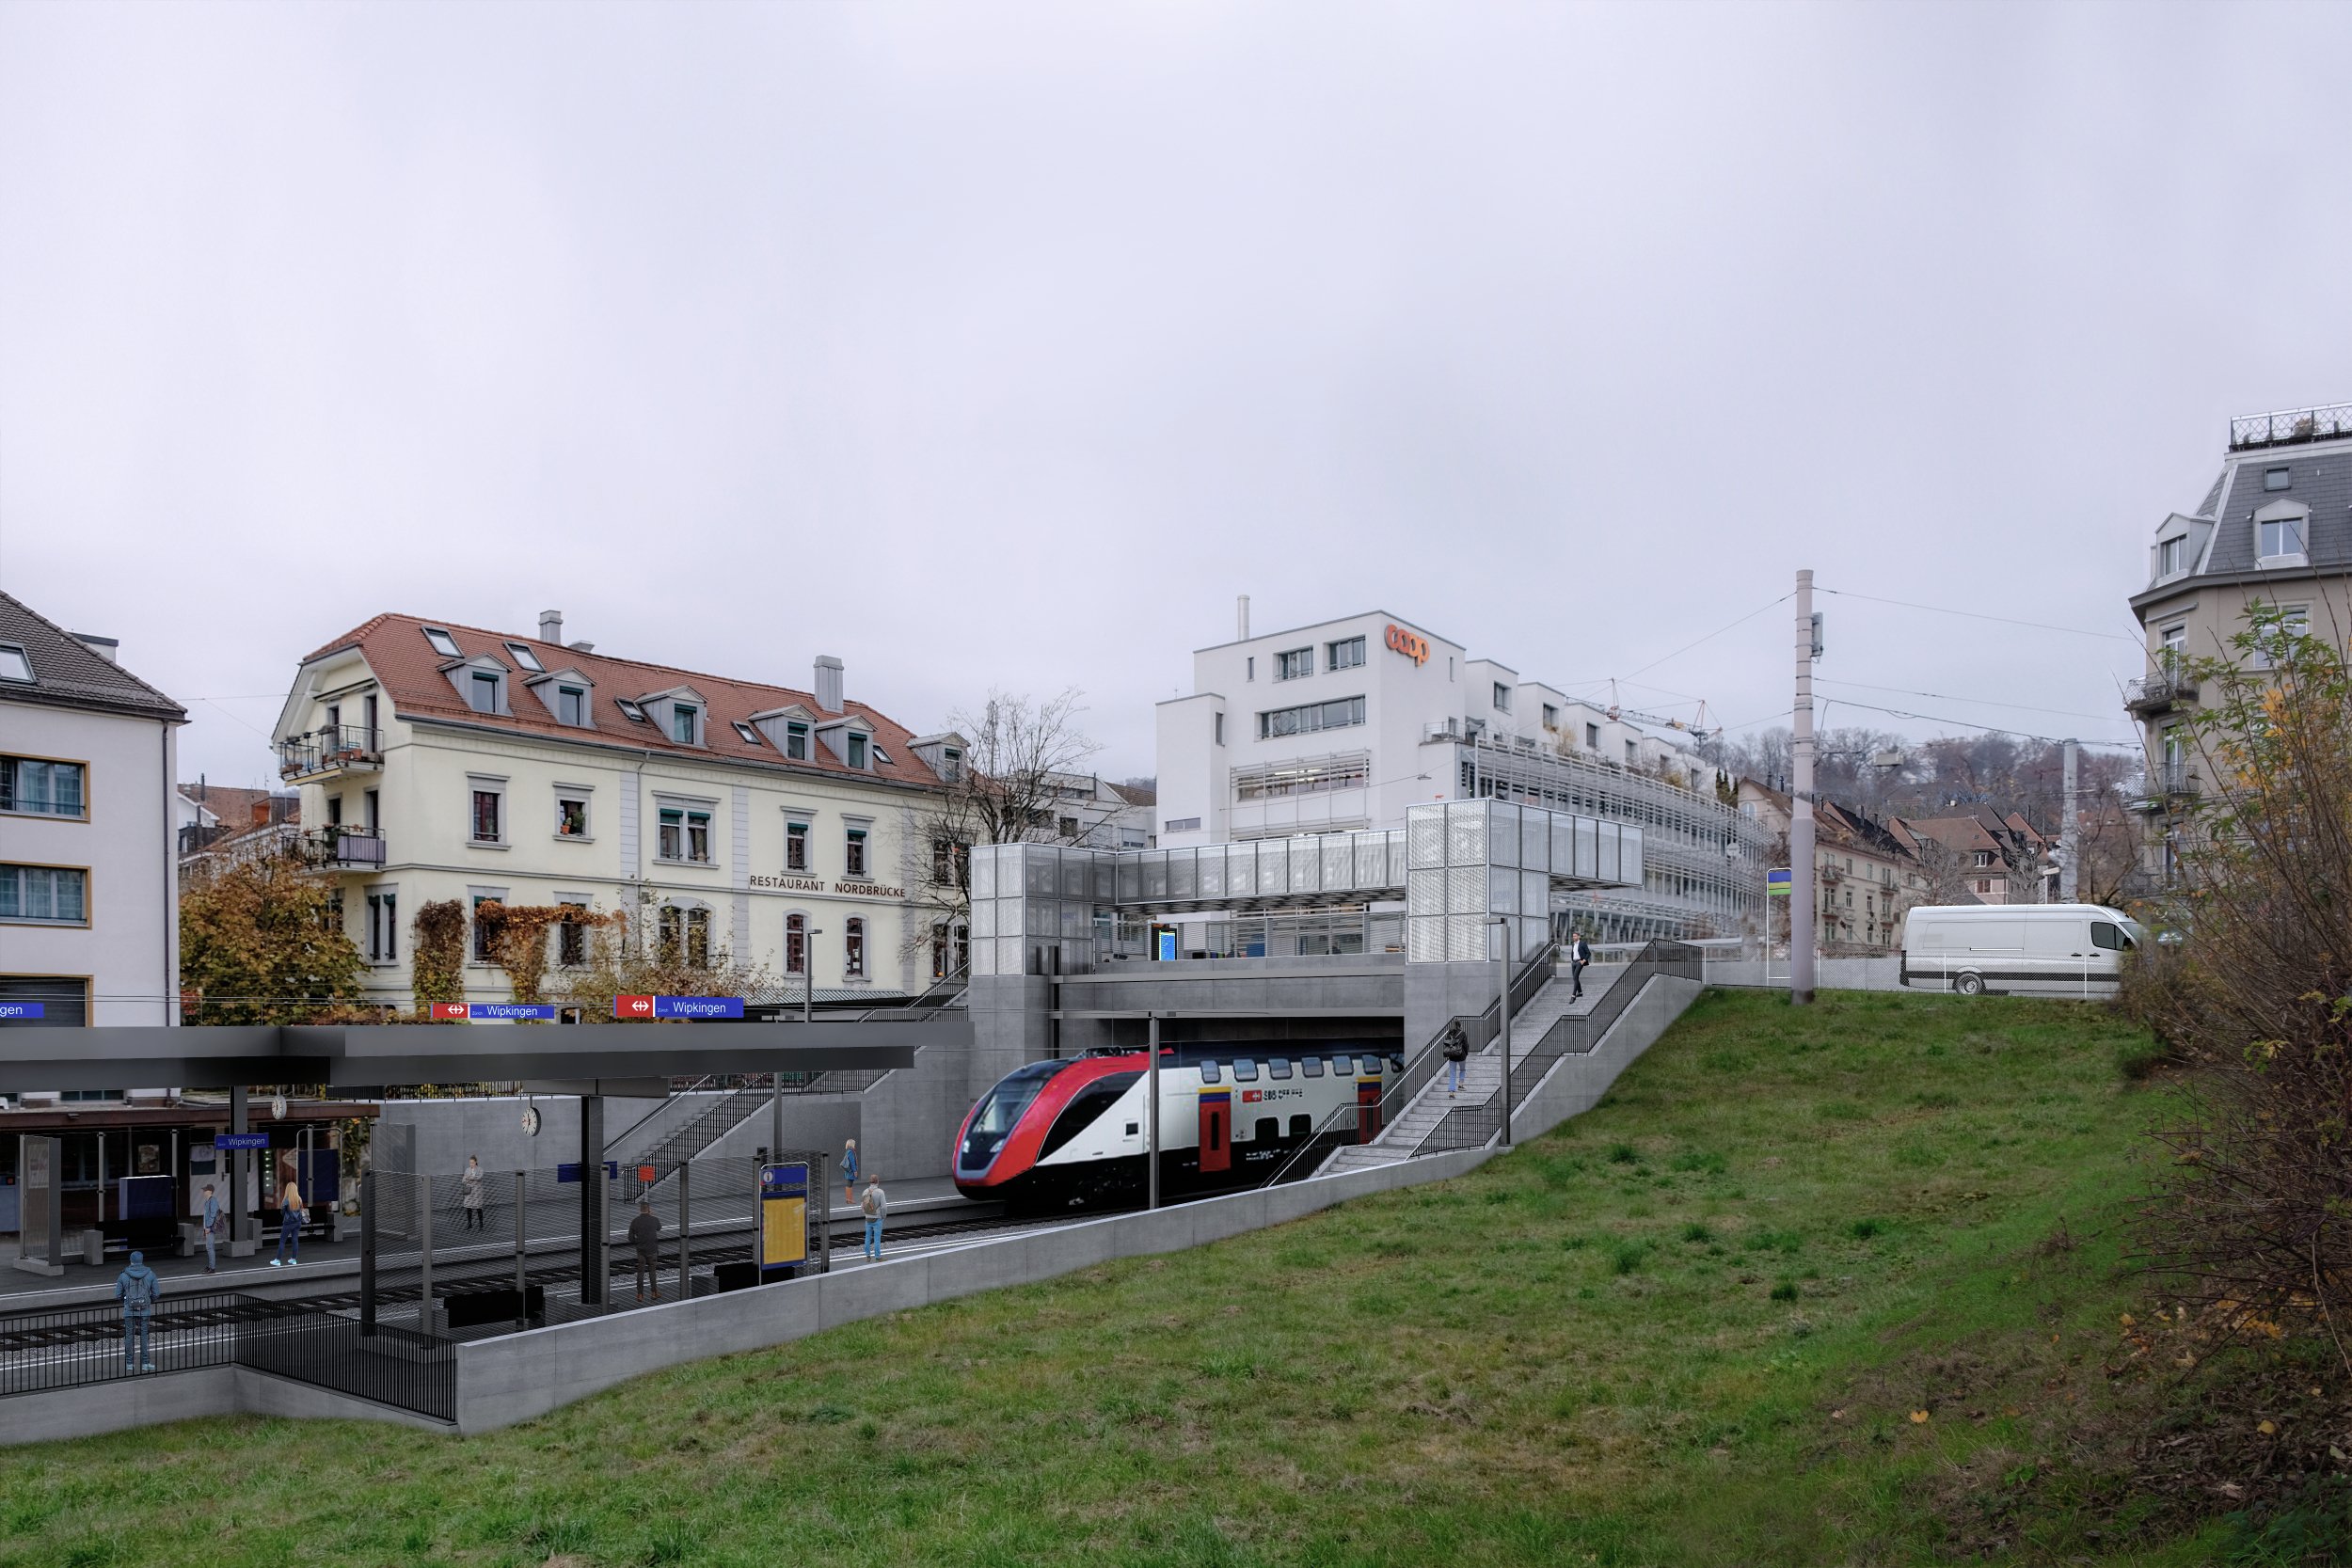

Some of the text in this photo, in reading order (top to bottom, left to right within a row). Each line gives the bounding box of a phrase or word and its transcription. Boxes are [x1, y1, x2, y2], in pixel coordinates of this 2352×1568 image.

[1384, 624, 1430, 667] coop
[750, 875, 905, 897] RESTAURANT NORDBRÜCKE
[486, 1006, 538, 1018] Wipkingen
[673, 1002, 726, 1016] Wipkingen
[228, 1138, 265, 1147] Wipkingen
